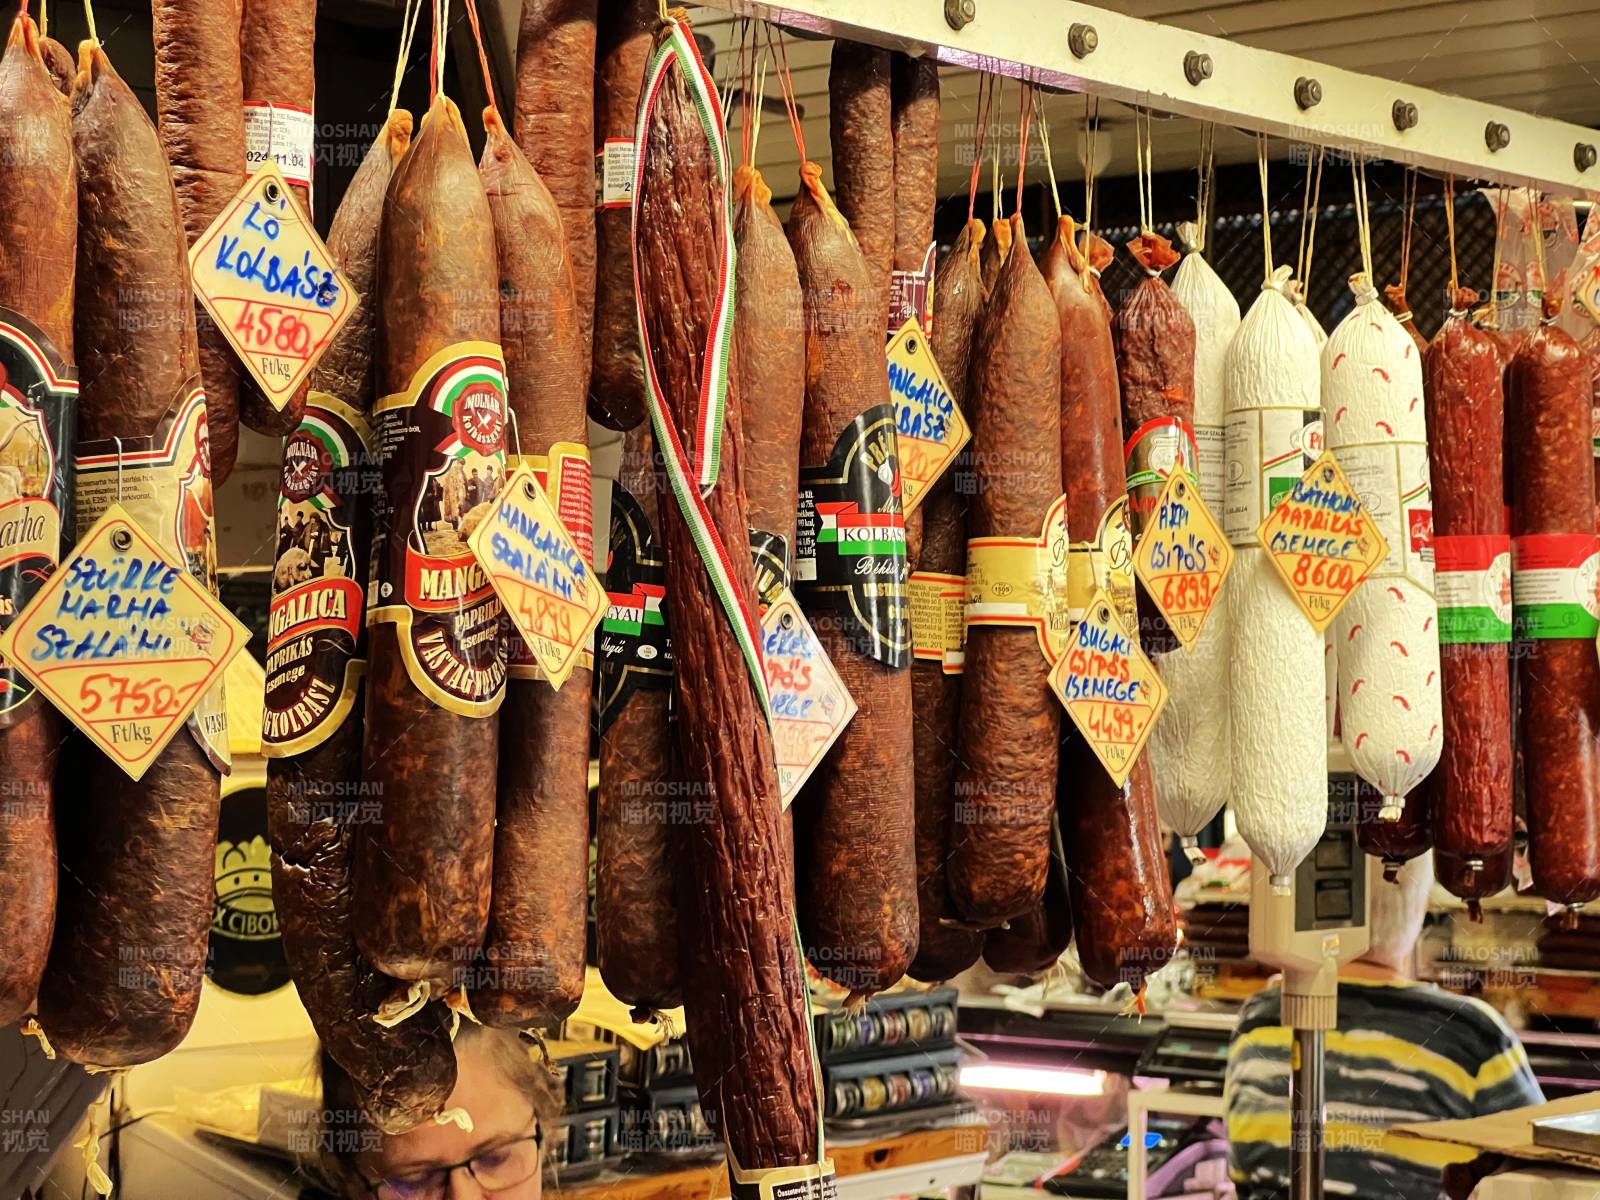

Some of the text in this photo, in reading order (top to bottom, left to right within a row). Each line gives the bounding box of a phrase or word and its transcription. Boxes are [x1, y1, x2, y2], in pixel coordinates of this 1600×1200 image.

[261, 358, 291, 381] Ft/kg
[464, 393, 500, 414] MOLNÁR
[64, 553, 181, 594] SZÜRKE
[1078, 621, 1131, 656] BUGACI
[1065, 674, 1140, 701] CSEMEGE
[111, 722, 152, 745] Ft/kg
